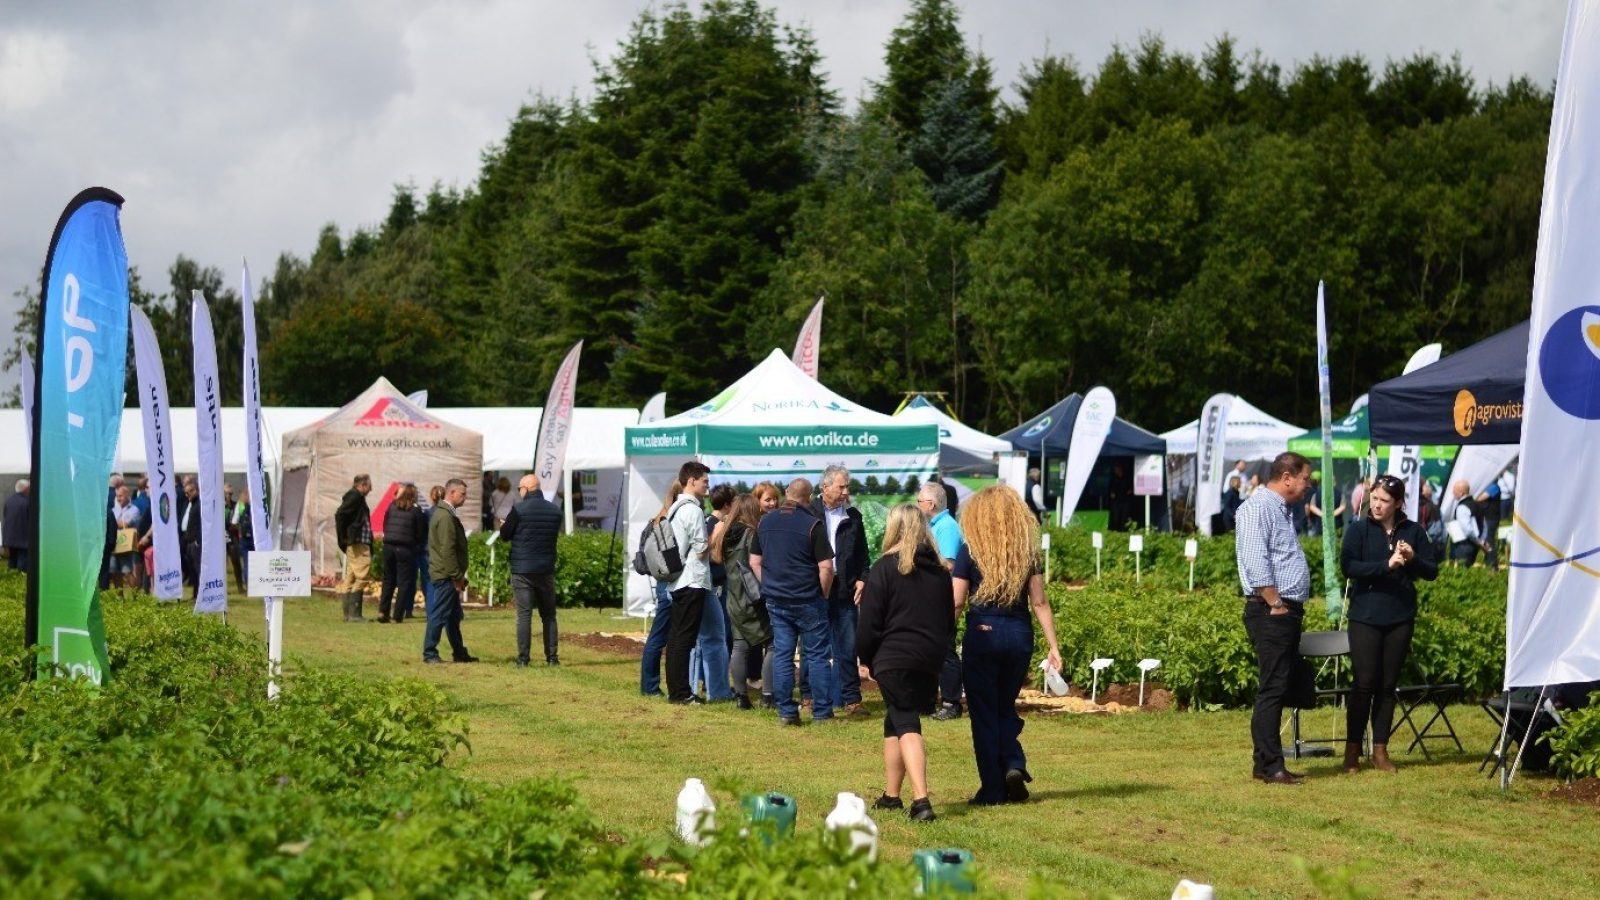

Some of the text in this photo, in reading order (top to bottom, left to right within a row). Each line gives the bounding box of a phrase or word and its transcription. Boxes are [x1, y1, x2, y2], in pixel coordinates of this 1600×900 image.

[1477, 400, 1524, 425] agrovist
[354, 418, 441, 430] AGRICO
[151, 386, 166, 488] Vixeran
[347, 437, 452, 450] www.agrico.co.uk
[759, 431, 880, 448] www.norika.de
[542, 455, 557, 480] Say
